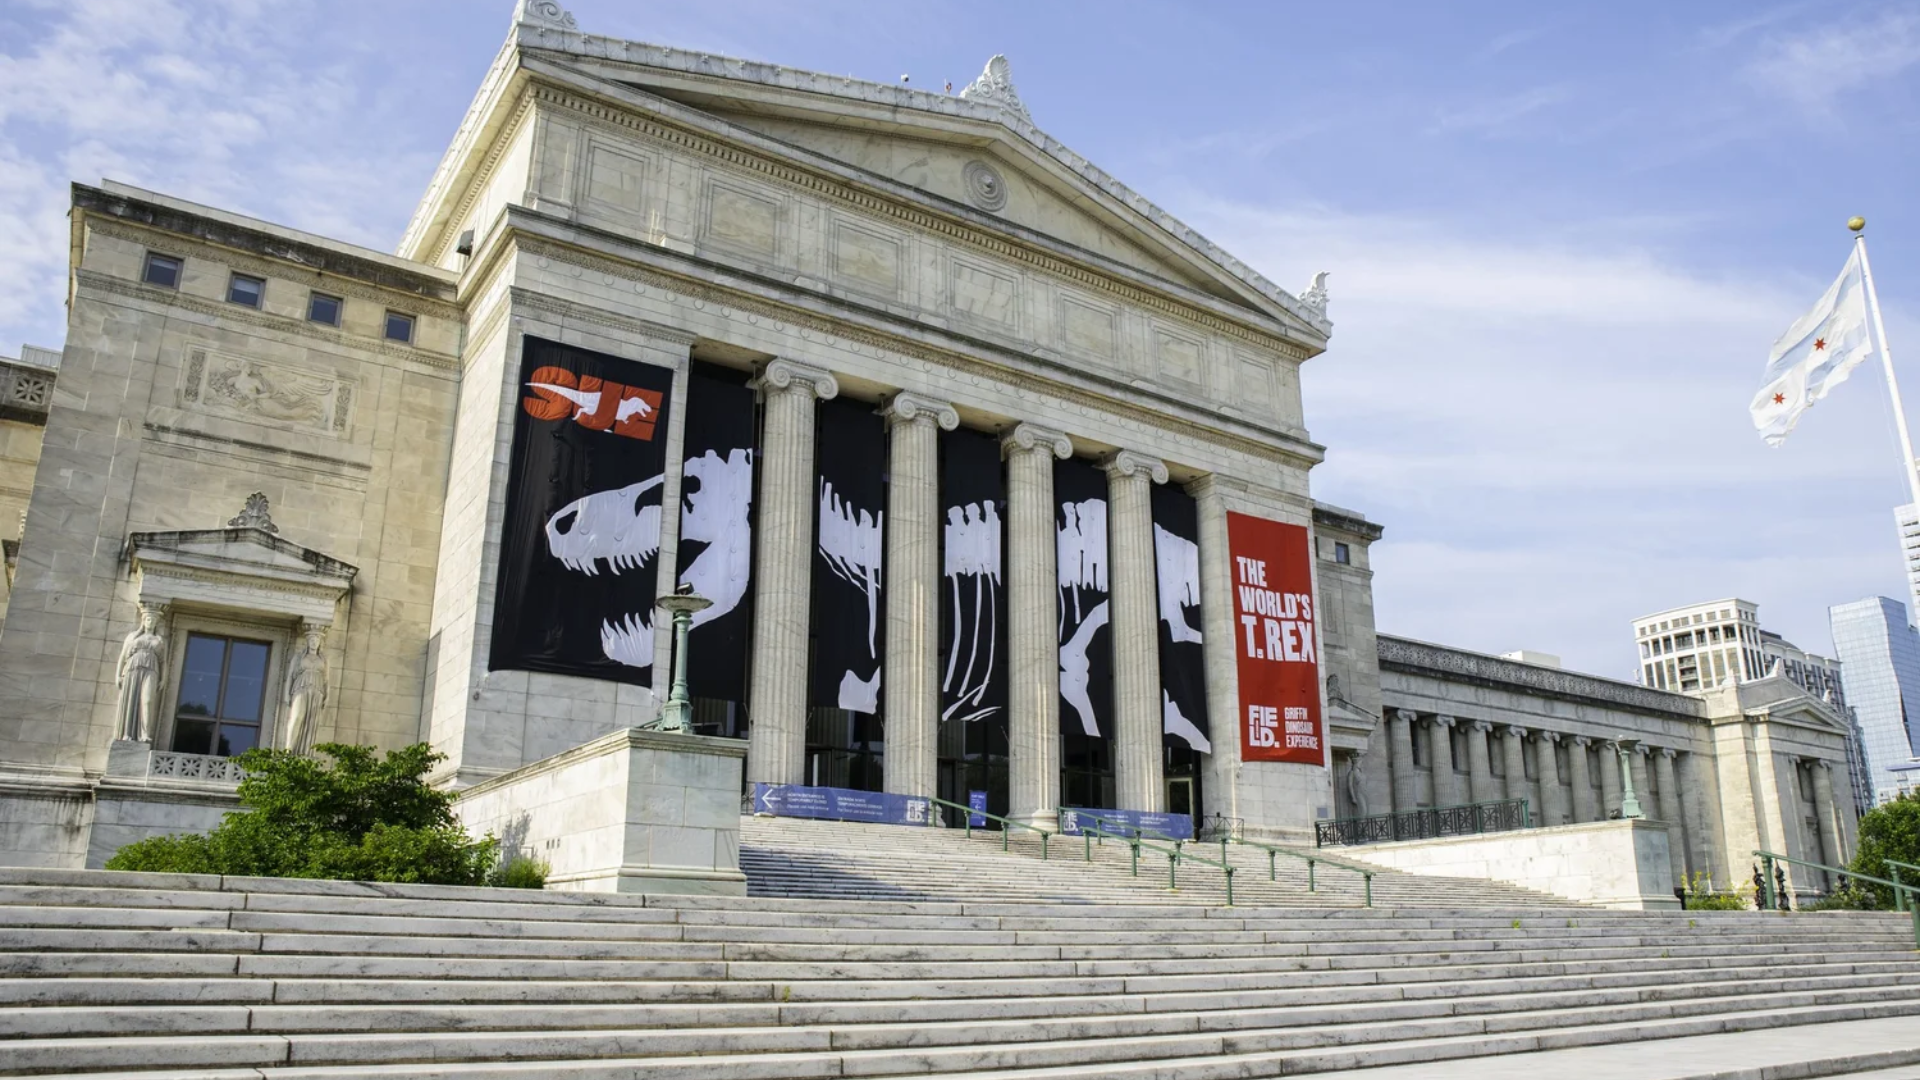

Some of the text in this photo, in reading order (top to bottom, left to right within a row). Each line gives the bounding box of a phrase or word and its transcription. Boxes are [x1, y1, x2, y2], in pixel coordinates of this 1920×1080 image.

[523, 365, 663, 441] SUE
[1236, 556, 1268, 588] THE
[1238, 585, 1312, 620] WORLD'S
[1241, 614, 1316, 664] T.REX
[1284, 706, 1308, 720] GRIFFIN
[1284, 720, 1314, 735] DINOSAUR
[1286, 734, 1318, 750] EXPERIENCE
